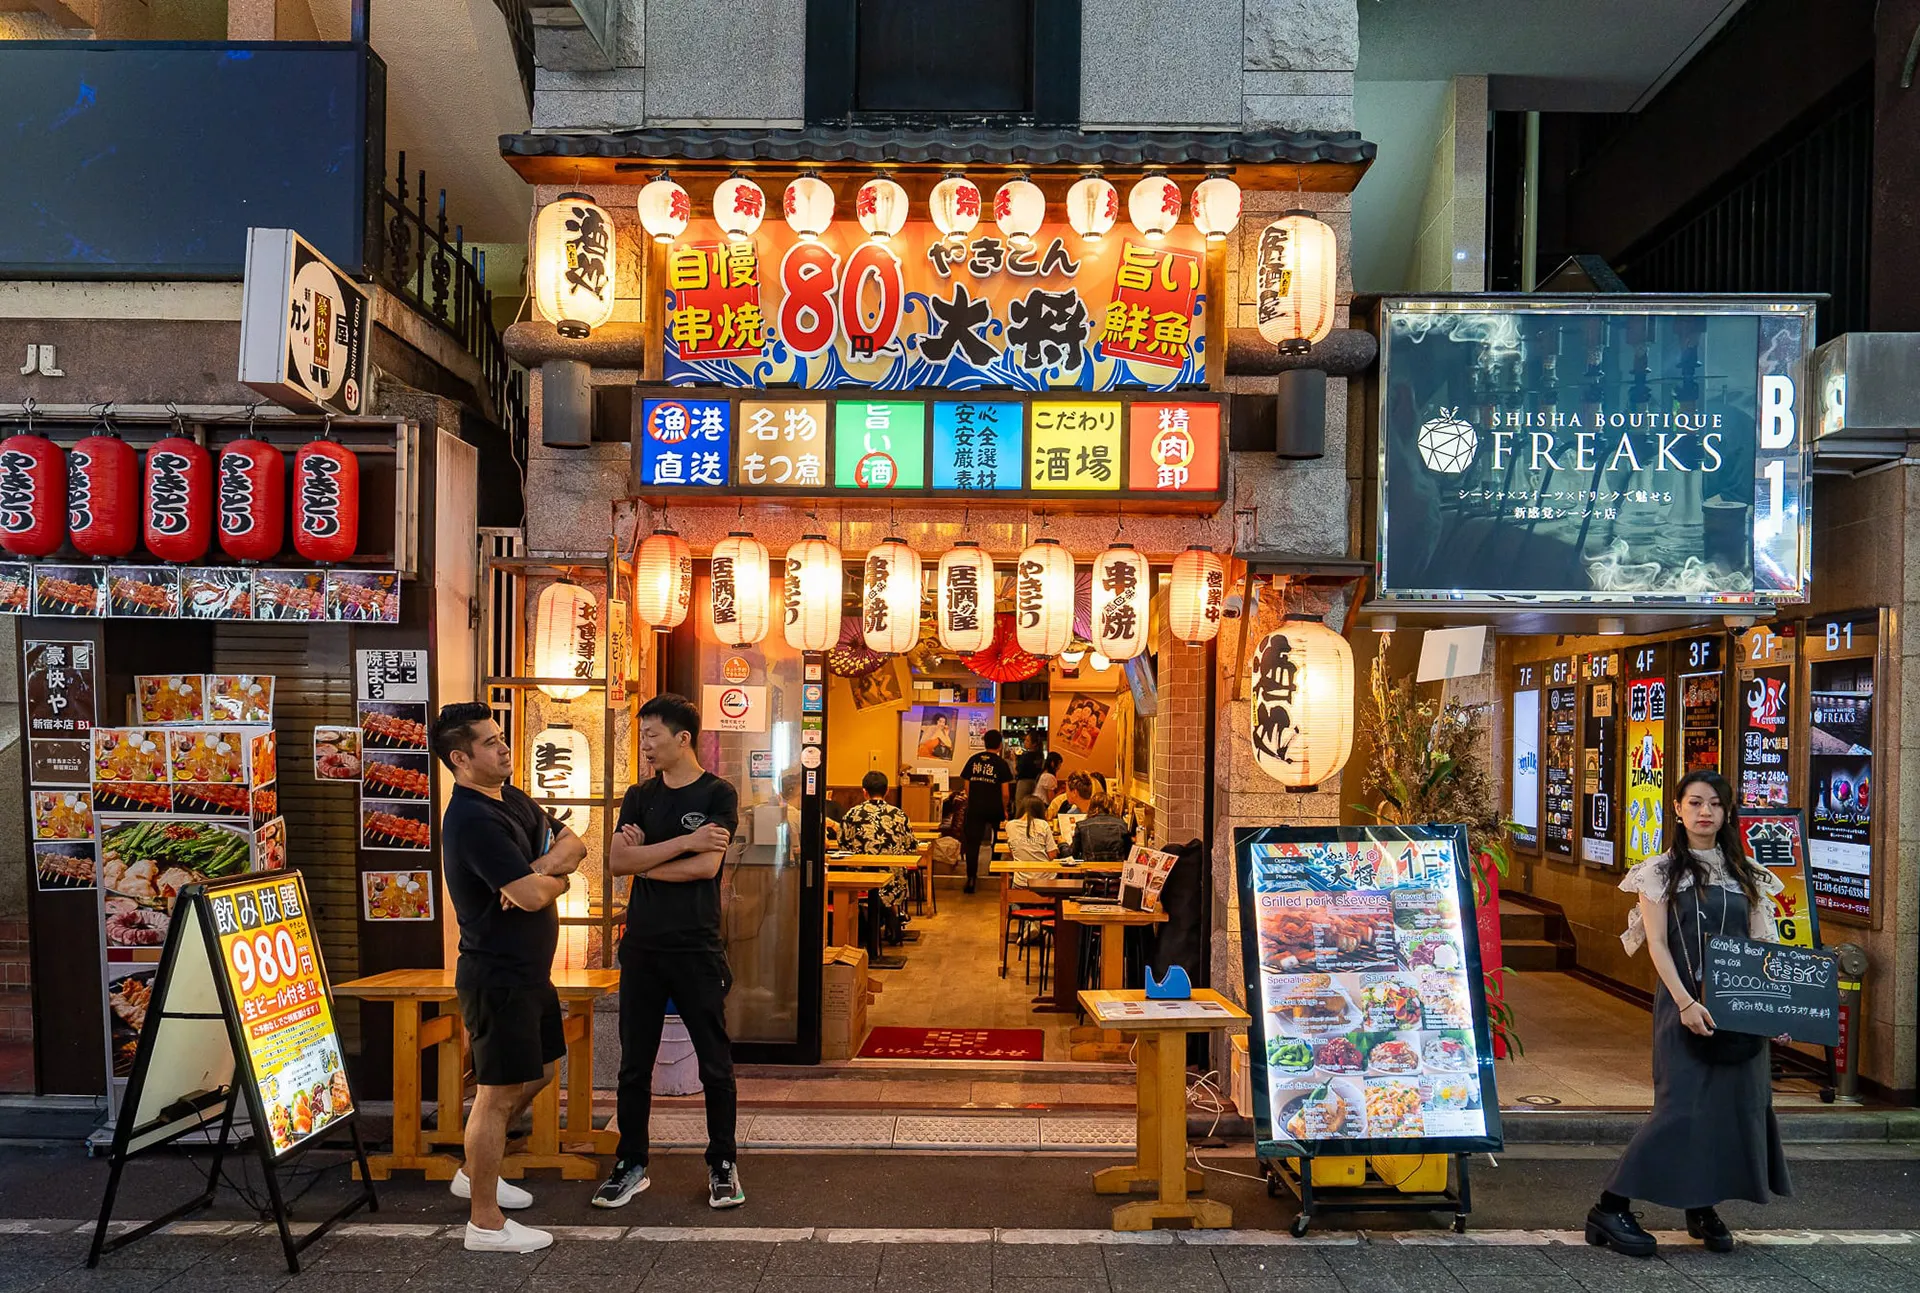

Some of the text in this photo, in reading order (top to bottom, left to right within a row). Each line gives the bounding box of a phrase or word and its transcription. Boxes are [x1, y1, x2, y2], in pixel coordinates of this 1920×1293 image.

[734, 184, 763, 218] 祭
[956, 185, 981, 218] 祭
[668, 241, 759, 290] 自慢
[928, 237, 1082, 277] やきとん
[1117, 243, 1200, 292] 旨い
[316, 294, 328, 357] 豪快や
[353, 298, 361, 328] FOOD
[674, 302, 766, 352] 串焼
[919, 282, 1089, 372] 大将
[1104, 301, 1191, 359] 鮮魚
[346, 384, 357, 404] B1
[653, 405, 725, 441] 漁港
[748, 407, 817, 441] 名物
[955, 403, 999, 423] 安心
[1035, 411, 1115, 431] こだわり
[1491, 411, 1724, 431] SHISHA BOUTIQUE
[861, 403, 894, 485] 旨い酒
[955, 426, 999, 445] 安全
[1157, 408, 1191, 490] 精肉卸
[954, 446, 998, 469] 厳選
[1035, 445, 1112, 483] 酒場
[1492, 431, 1724, 473] FREAKS
[1760, 374, 1796, 535] B1
[653, 451, 723, 486] 直送
[742, 452, 822, 486] もつ煮
[954, 470, 998, 490] 素材
[1513, 506, 1618, 520] 新感覚シーシャ店
[946, 564, 979, 632] 居酒屋
[1102, 560, 1138, 640] 串焼
[1205, 570, 1223, 624] 営業中
[1751, 633, 1776, 660] 2F
[1826, 622, 1852, 652] B1
[1592, 656, 1608, 678] 5F
[1635, 650, 1655, 672] 4F
[1689, 641, 1710, 667] 3F
[45, 645, 68, 714] 豪快や
[1519, 667, 1533, 686] 7F
[1553, 662, 1567, 683] 6F
[1631, 681, 1666, 721] 麻雀
[32, 719, 91, 731] 新宿本店 B1
[1760, 715, 1786, 725] GYUFUKU
[1823, 711, 1856, 723] FREAKS
[1631, 768, 1663, 788] ZIPANG
[1327, 863, 1377, 888] 大将
[1399, 848, 1439, 880] 1F
[212, 883, 303, 934] 飲み放題
[1260, 893, 1388, 909] Grilled pork skewers
[232, 926, 298, 992] 980
[1744, 942, 1766, 956] bar
[1789, 950, 1812, 961] Open
[301, 954, 314, 975] 円
[1365, 973, 1389, 982] Salad
[1267, 976, 1312, 986] Specialties
